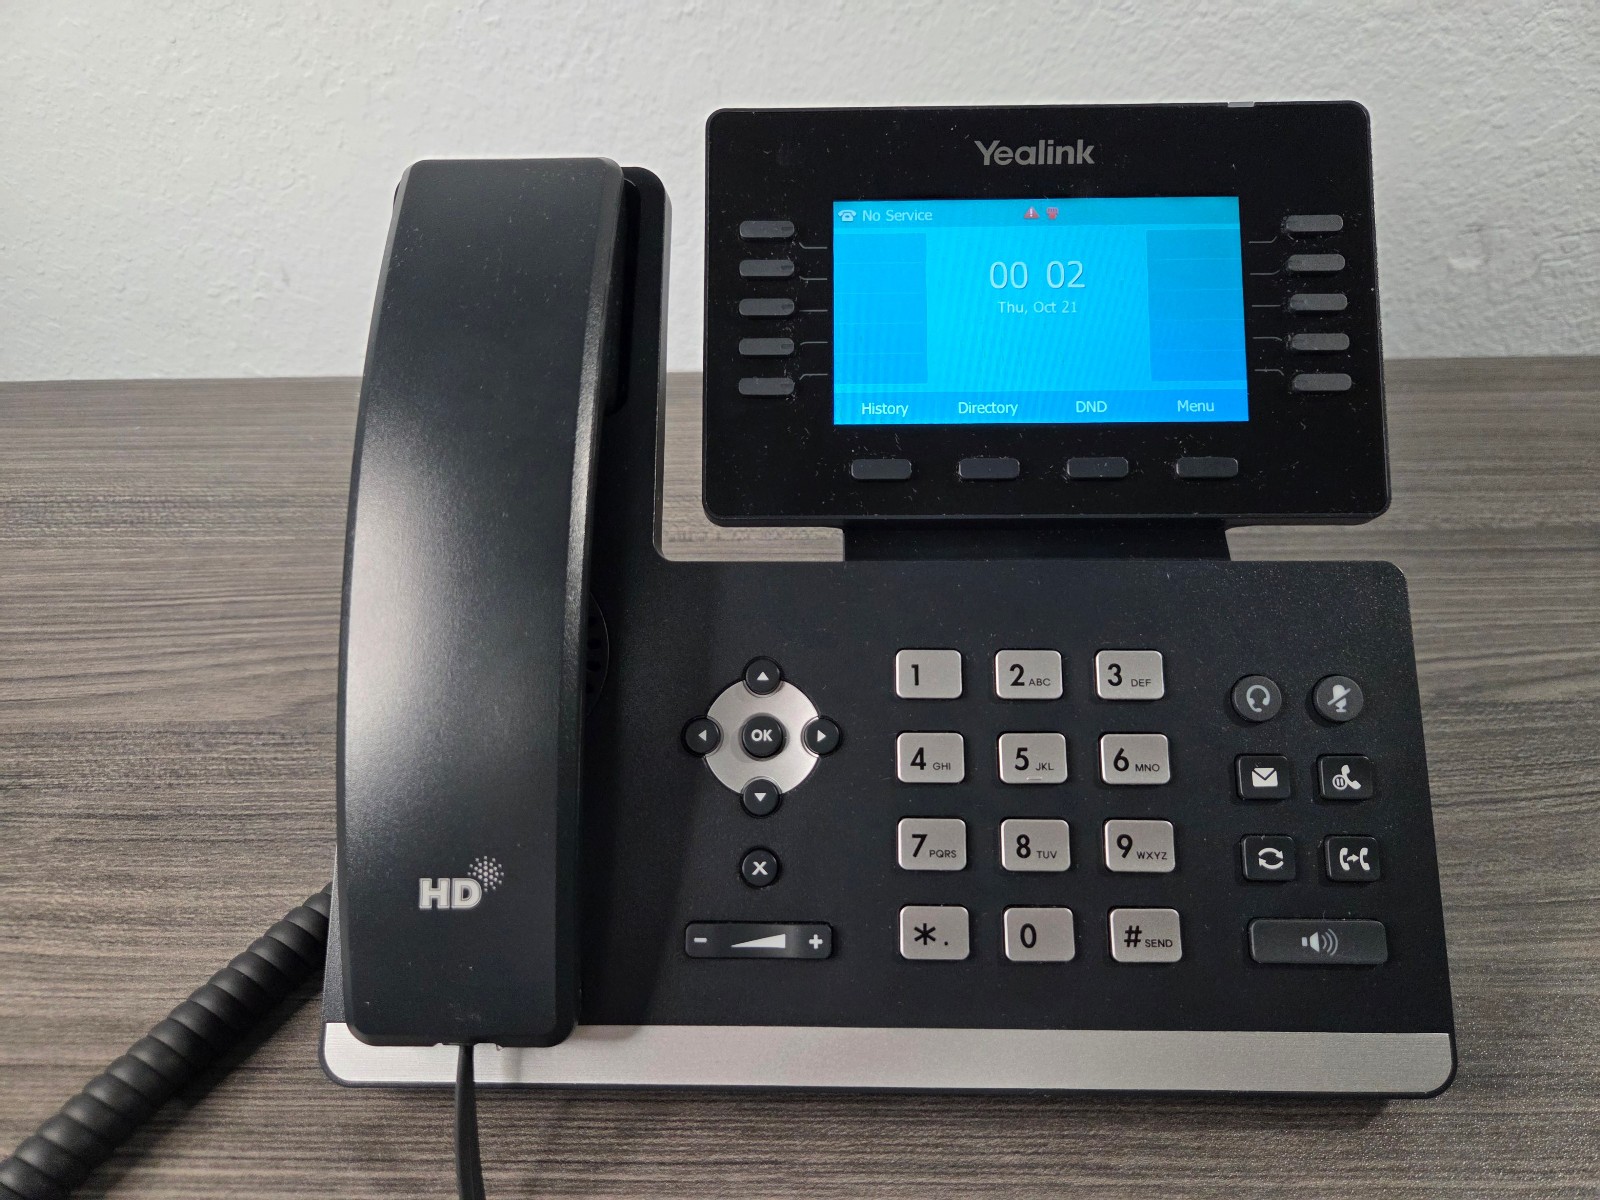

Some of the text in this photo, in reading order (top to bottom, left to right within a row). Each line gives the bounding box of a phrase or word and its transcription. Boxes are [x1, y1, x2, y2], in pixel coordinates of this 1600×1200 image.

[974, 139, 1095, 166] Yealink
[862, 208, 933, 222] No Service
[989, 260, 1086, 289] 00 02
[998, 301, 1078, 315] Thu, Oct 21
[861, 402, 909, 418] History
[957, 401, 1018, 417] Directory
[1075, 401, 1108, 413] DND
[1177, 400, 1215, 413] Menu
[910, 664, 920, 686] 1
[1009, 664, 1051, 686] 2 ABC
[1107, 663, 1152, 687] 3 DEF
[751, 729, 773, 742] OK
[910, 747, 952, 771] 4 GHI
[1014, 747, 1054, 771] 5 JKL
[1113, 748, 1160, 772] 6 MNO
[911, 834, 957, 859] 7 PQRS
[1016, 834, 1058, 859] 8 TUV
[1116, 834, 1168, 860] 9 WXYZ
[419, 878, 482, 910] HD
[1020, 923, 1037, 949] 0
[1145, 939, 1173, 948] SEND
